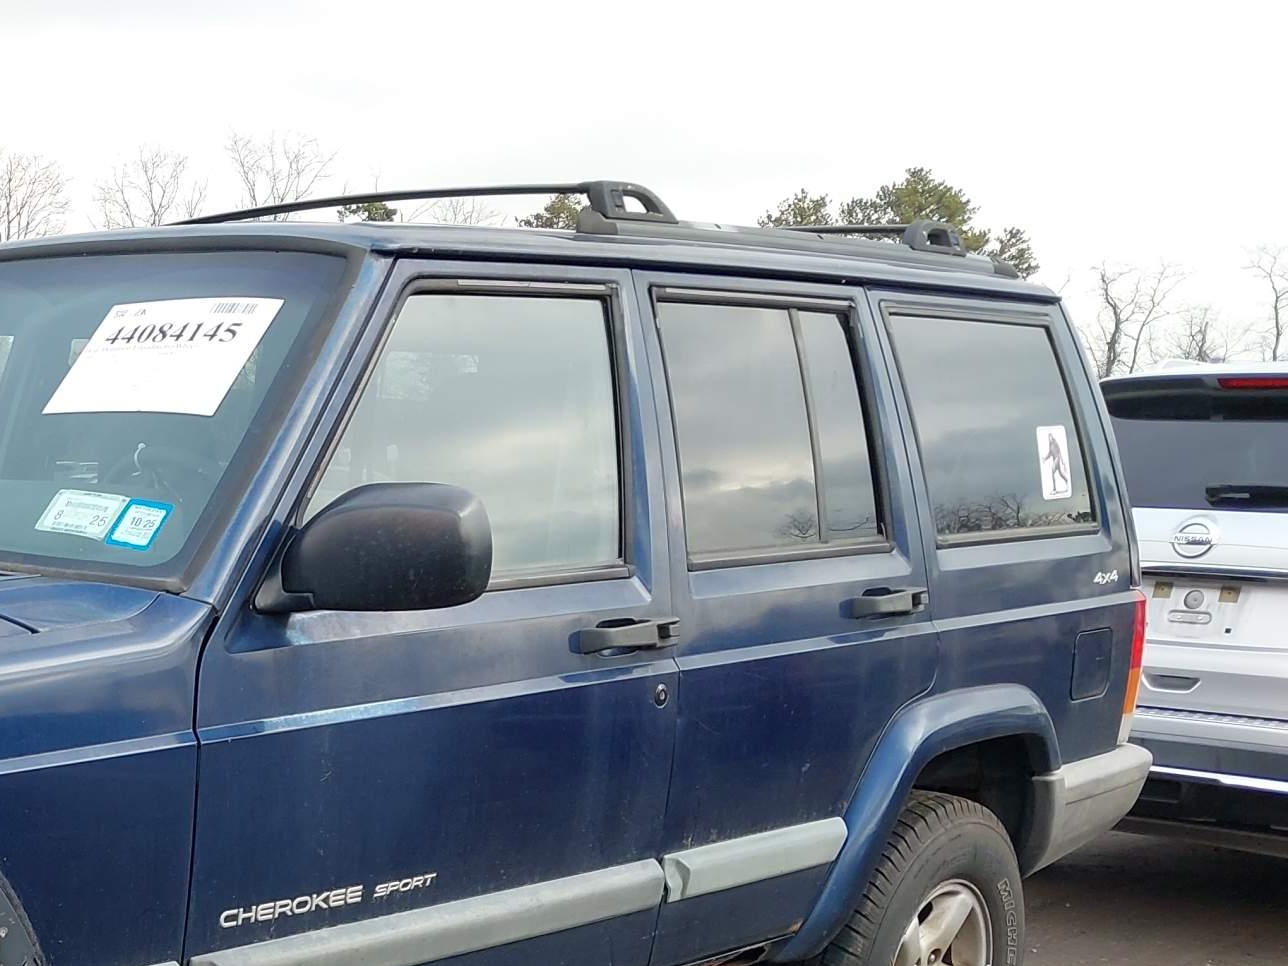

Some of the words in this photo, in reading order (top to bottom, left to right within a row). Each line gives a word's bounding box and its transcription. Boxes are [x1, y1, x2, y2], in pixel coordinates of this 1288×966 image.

[105, 321, 243, 345] 44084145
[89, 514, 109, 527] 25
[130, 516, 142, 527] 10
[143, 519, 157, 529] 25
[1174, 535, 1212, 544] NISSAN
[219, 884, 364, 929] CHEROKEE
[373, 872, 438, 898] SPORT
